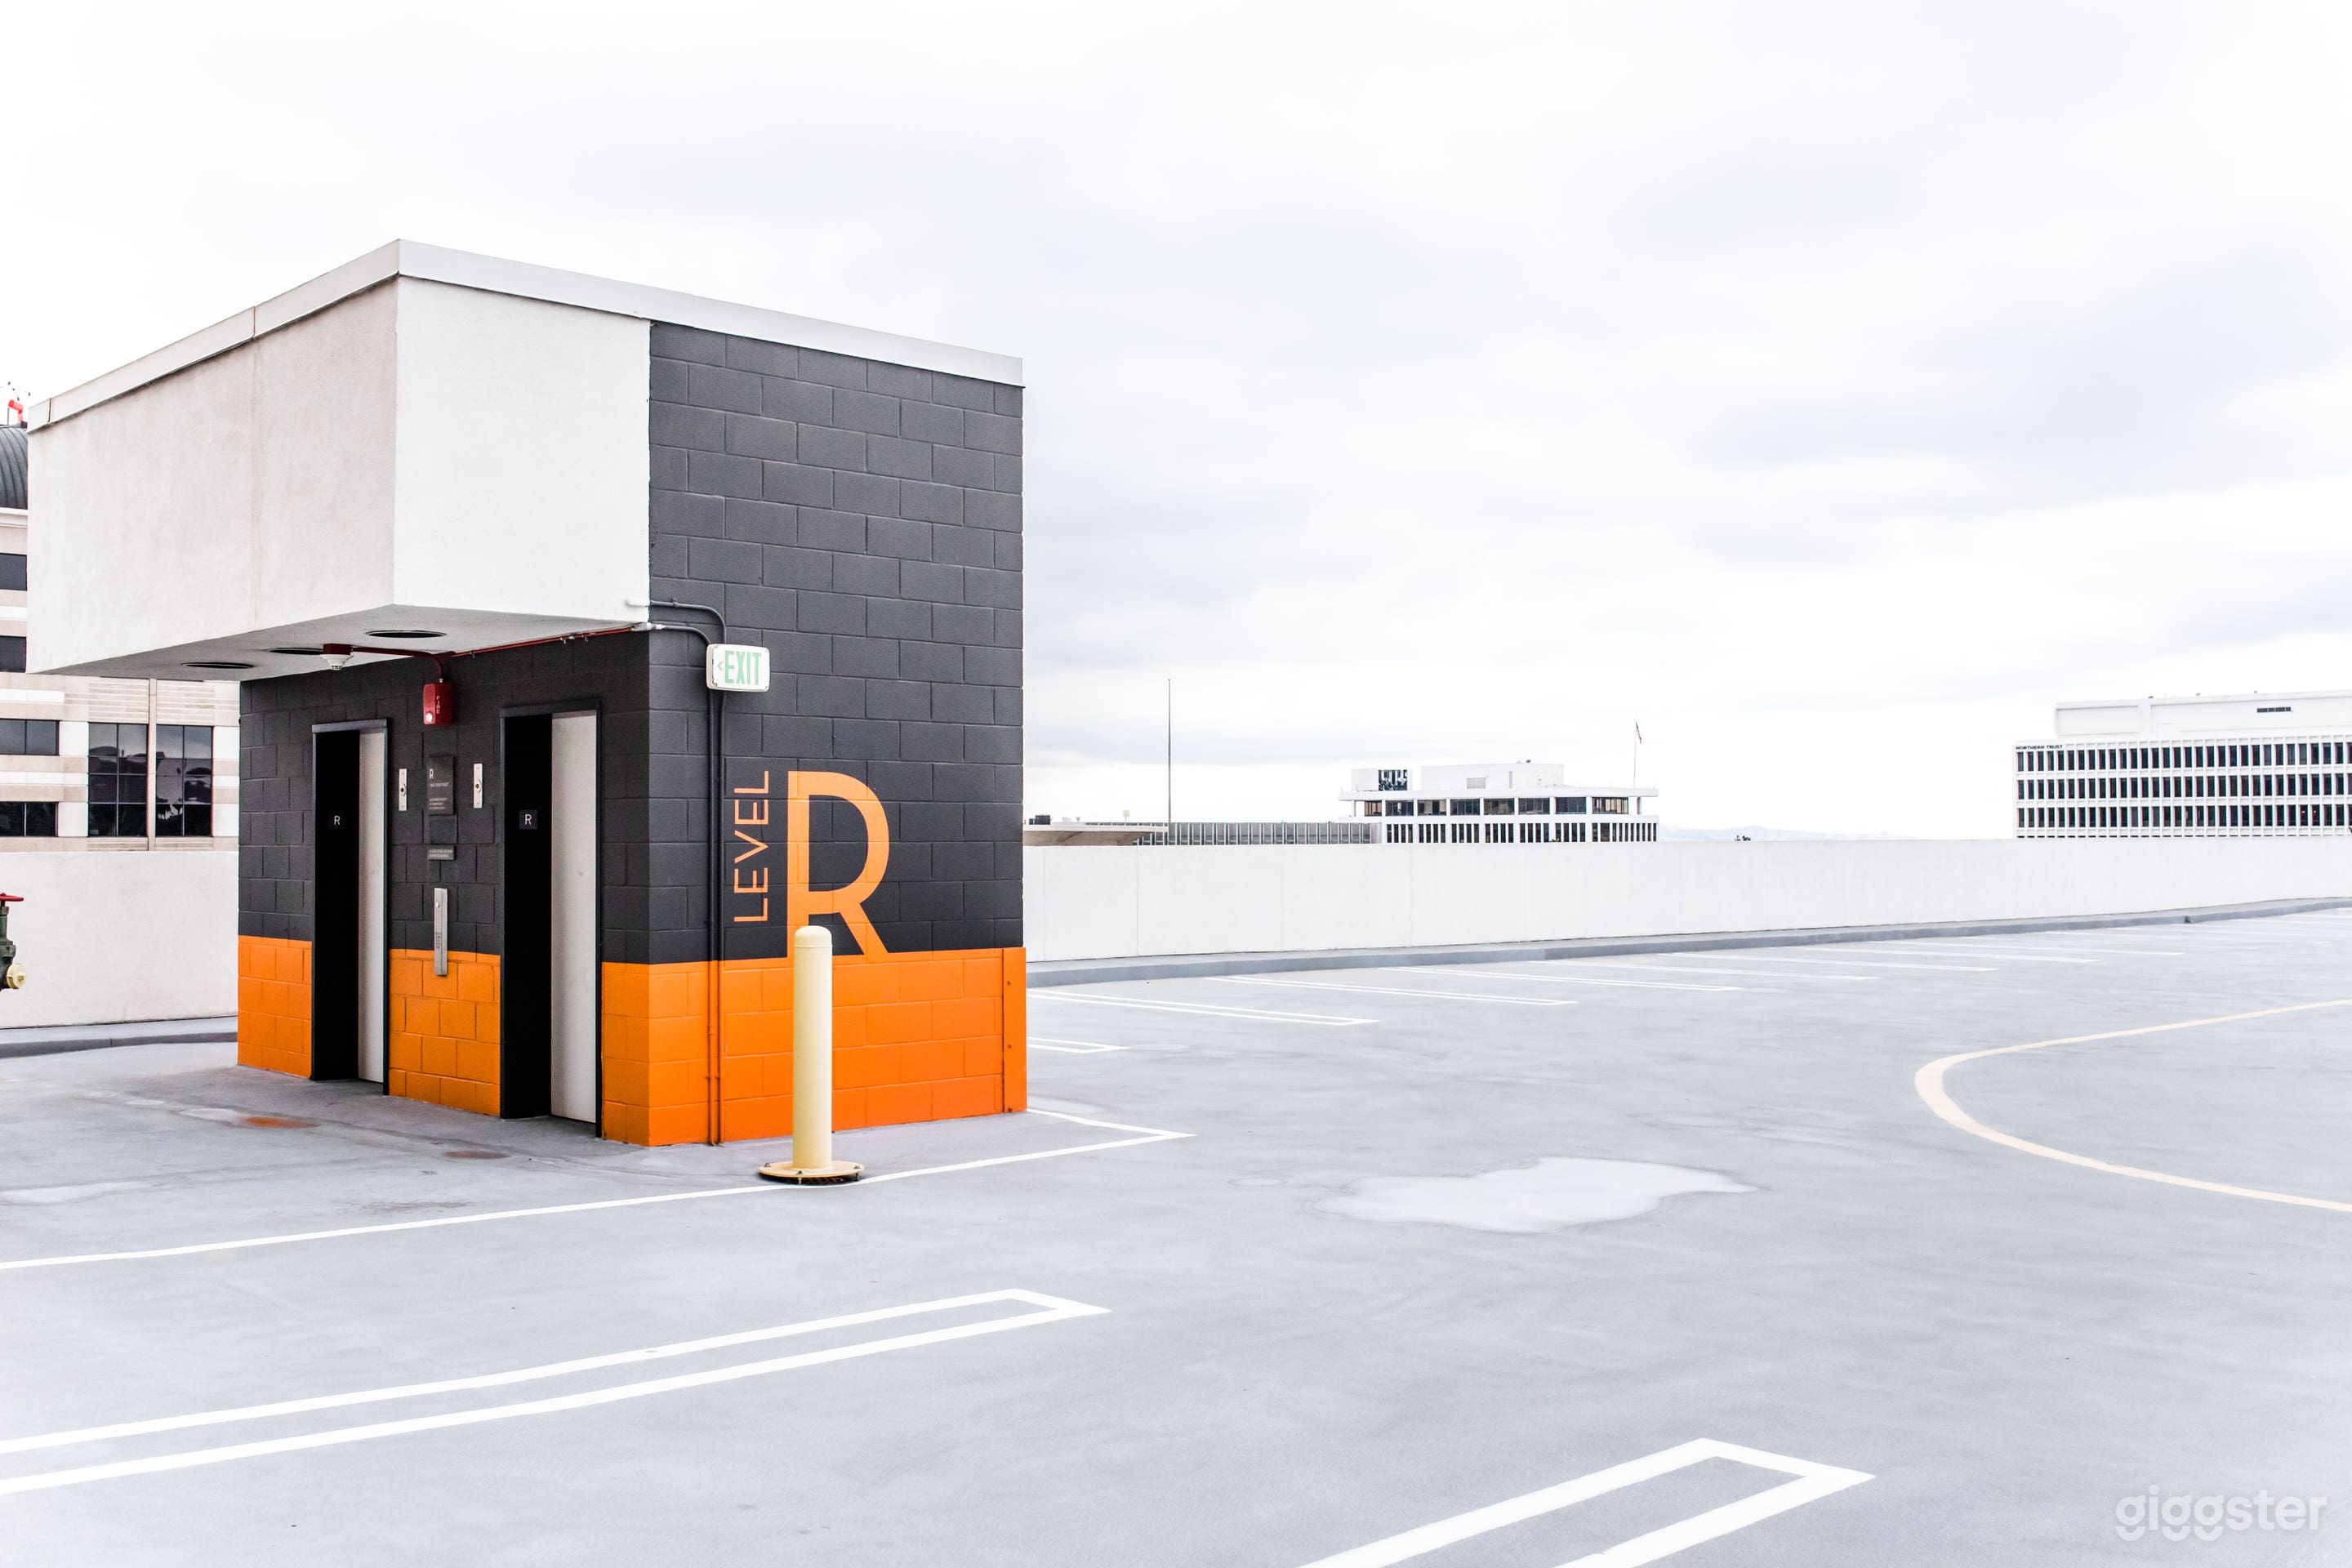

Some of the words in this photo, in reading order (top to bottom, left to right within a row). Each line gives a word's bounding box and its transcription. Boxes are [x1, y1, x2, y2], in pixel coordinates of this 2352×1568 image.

[725, 650, 761, 685] EXIT
[429, 768, 434, 780] R
[334, 815, 341, 825] R
[524, 813, 532, 825] R
[734, 771, 769, 922] LEVEL
[787, 771, 889, 957] R
